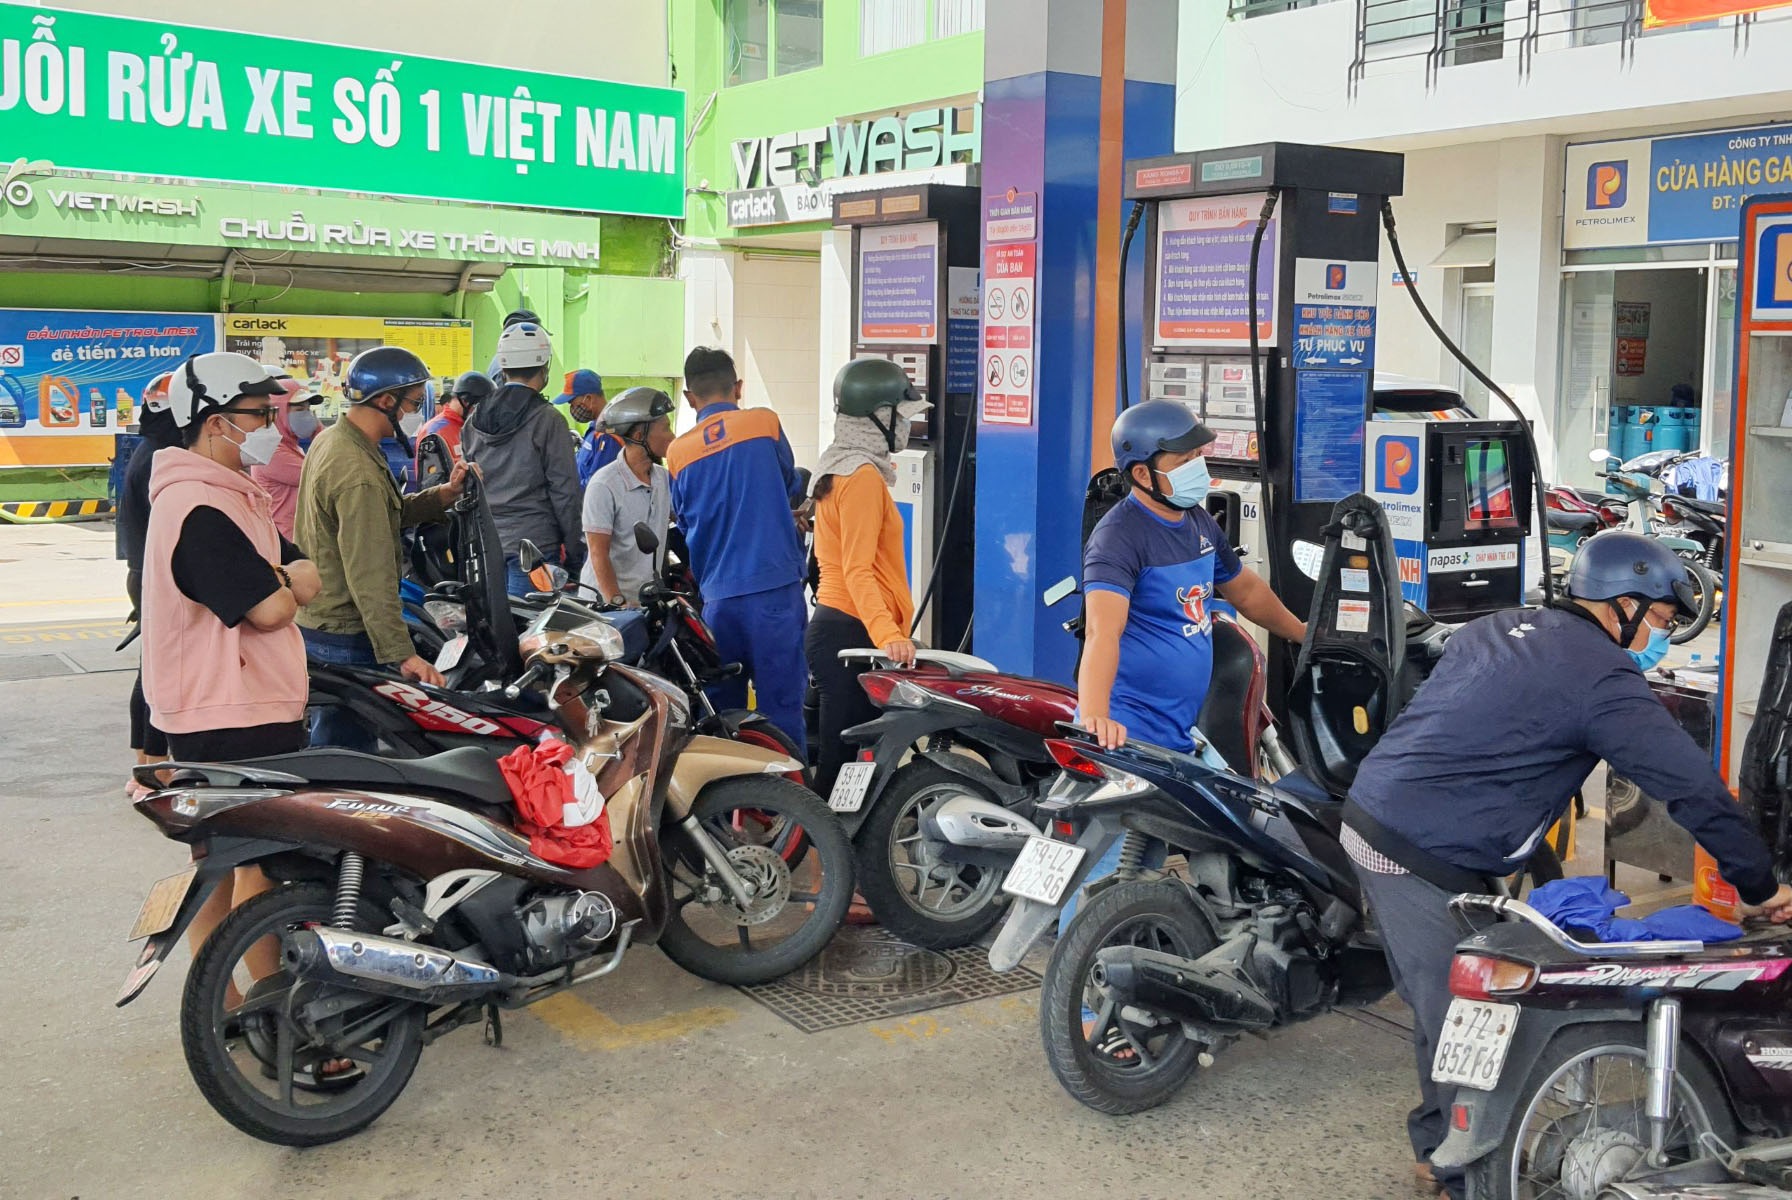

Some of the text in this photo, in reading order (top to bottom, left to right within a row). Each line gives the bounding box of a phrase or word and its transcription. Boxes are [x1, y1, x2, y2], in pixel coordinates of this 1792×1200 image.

[107, 32, 226, 131] RỬA
[244, 66, 314, 140] XE
[333, 60, 403, 149] SỐ
[419, 89, 440, 152] 1
[462, 86, 562, 176] VIỆT
[576, 106, 676, 175] NAM
[1728, 136, 1757, 150] CÔNG
[1759, 136, 1771, 147] TY
[1656, 158, 1699, 192] CỬA
[1704, 155, 1761, 188] HÀNG
[731, 191, 776, 220] carlack
[1575, 216, 1636, 226] PETROLIMEX
[220, 211, 316, 242] CHUỖI
[399, 229, 436, 250] XE
[444, 230, 534, 256] THÔNG
[541, 239, 600, 260] MINH
[1307, 292, 1341, 300] Petrolimex
[26, 325, 58, 340] DẦU
[101, 326, 199, 339] PETROLIMEX
[233, 319, 287, 330] carlack
[77, 342, 117, 361] tiến
[121, 346, 146, 359] xa
[150, 344, 181, 357] hơn
[1317, 338, 1346, 356] PHỤC
[1349, 340, 1365, 356] VỤ
[912, 482, 921, 494] 09
[1243, 503, 1257, 519] 06
[1430, 554, 1462, 568] napas
[374, 680, 500, 735] R150
[1028, 840, 1074, 872] 59-L2
[1586, 964, 1682, 982] Dream
[1464, 1007, 1492, 1040] 72
[1438, 1042, 1498, 1079] 852F6
